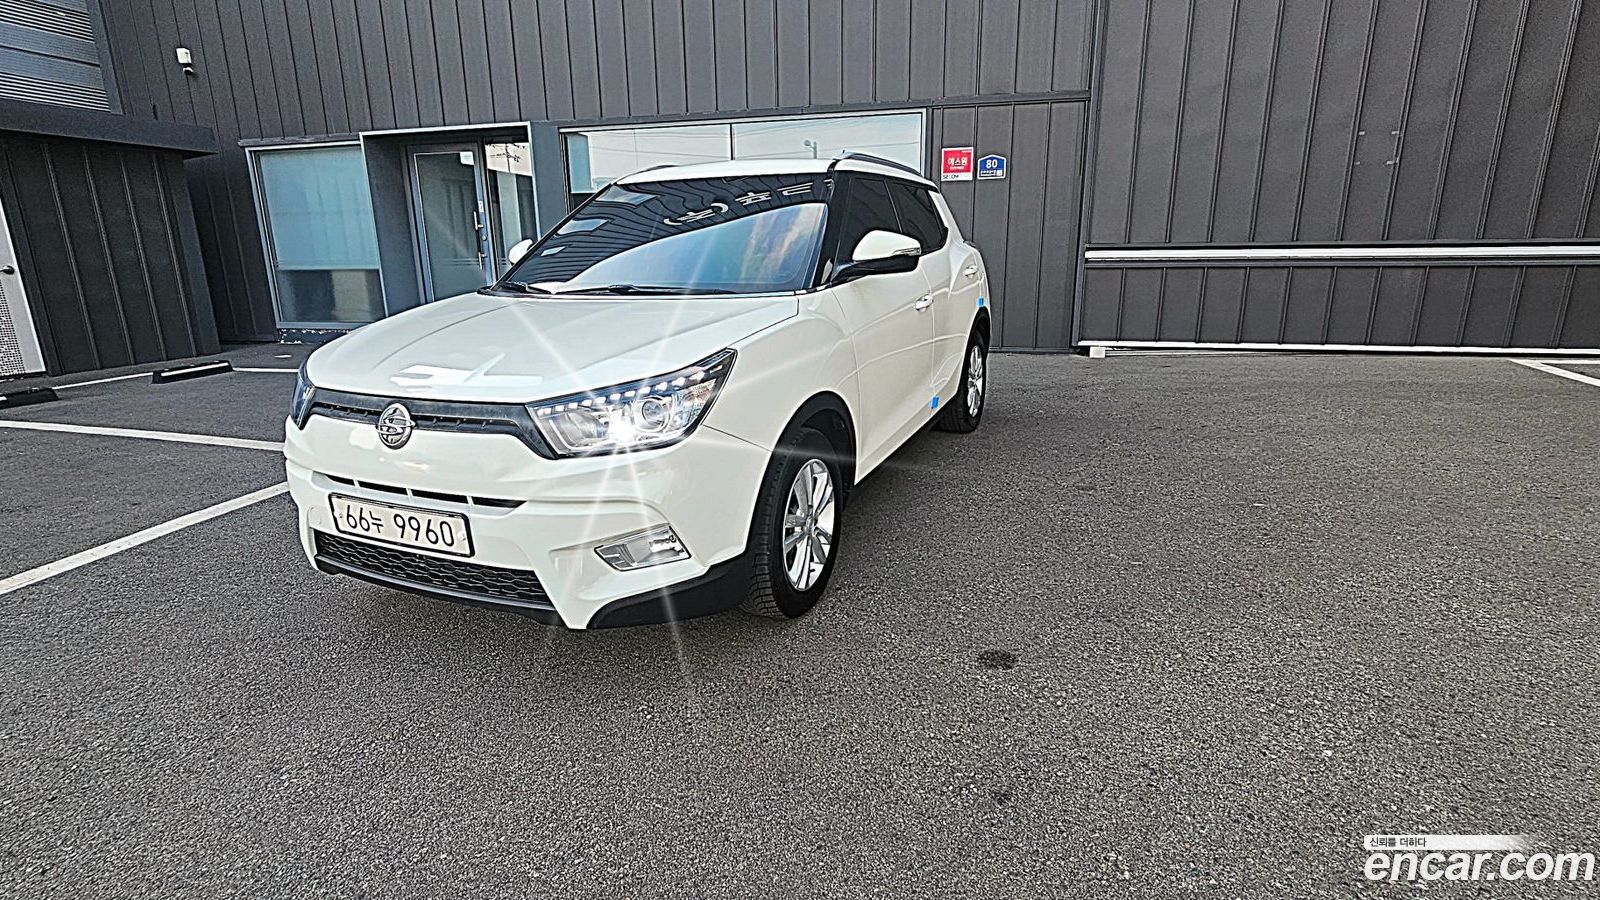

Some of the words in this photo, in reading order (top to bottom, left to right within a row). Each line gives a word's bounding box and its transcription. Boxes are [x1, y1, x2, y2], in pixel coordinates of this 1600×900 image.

[986, 159, 998, 169] 80
[346, 505, 384, 534] 66누
[393, 513, 455, 547] 9960
